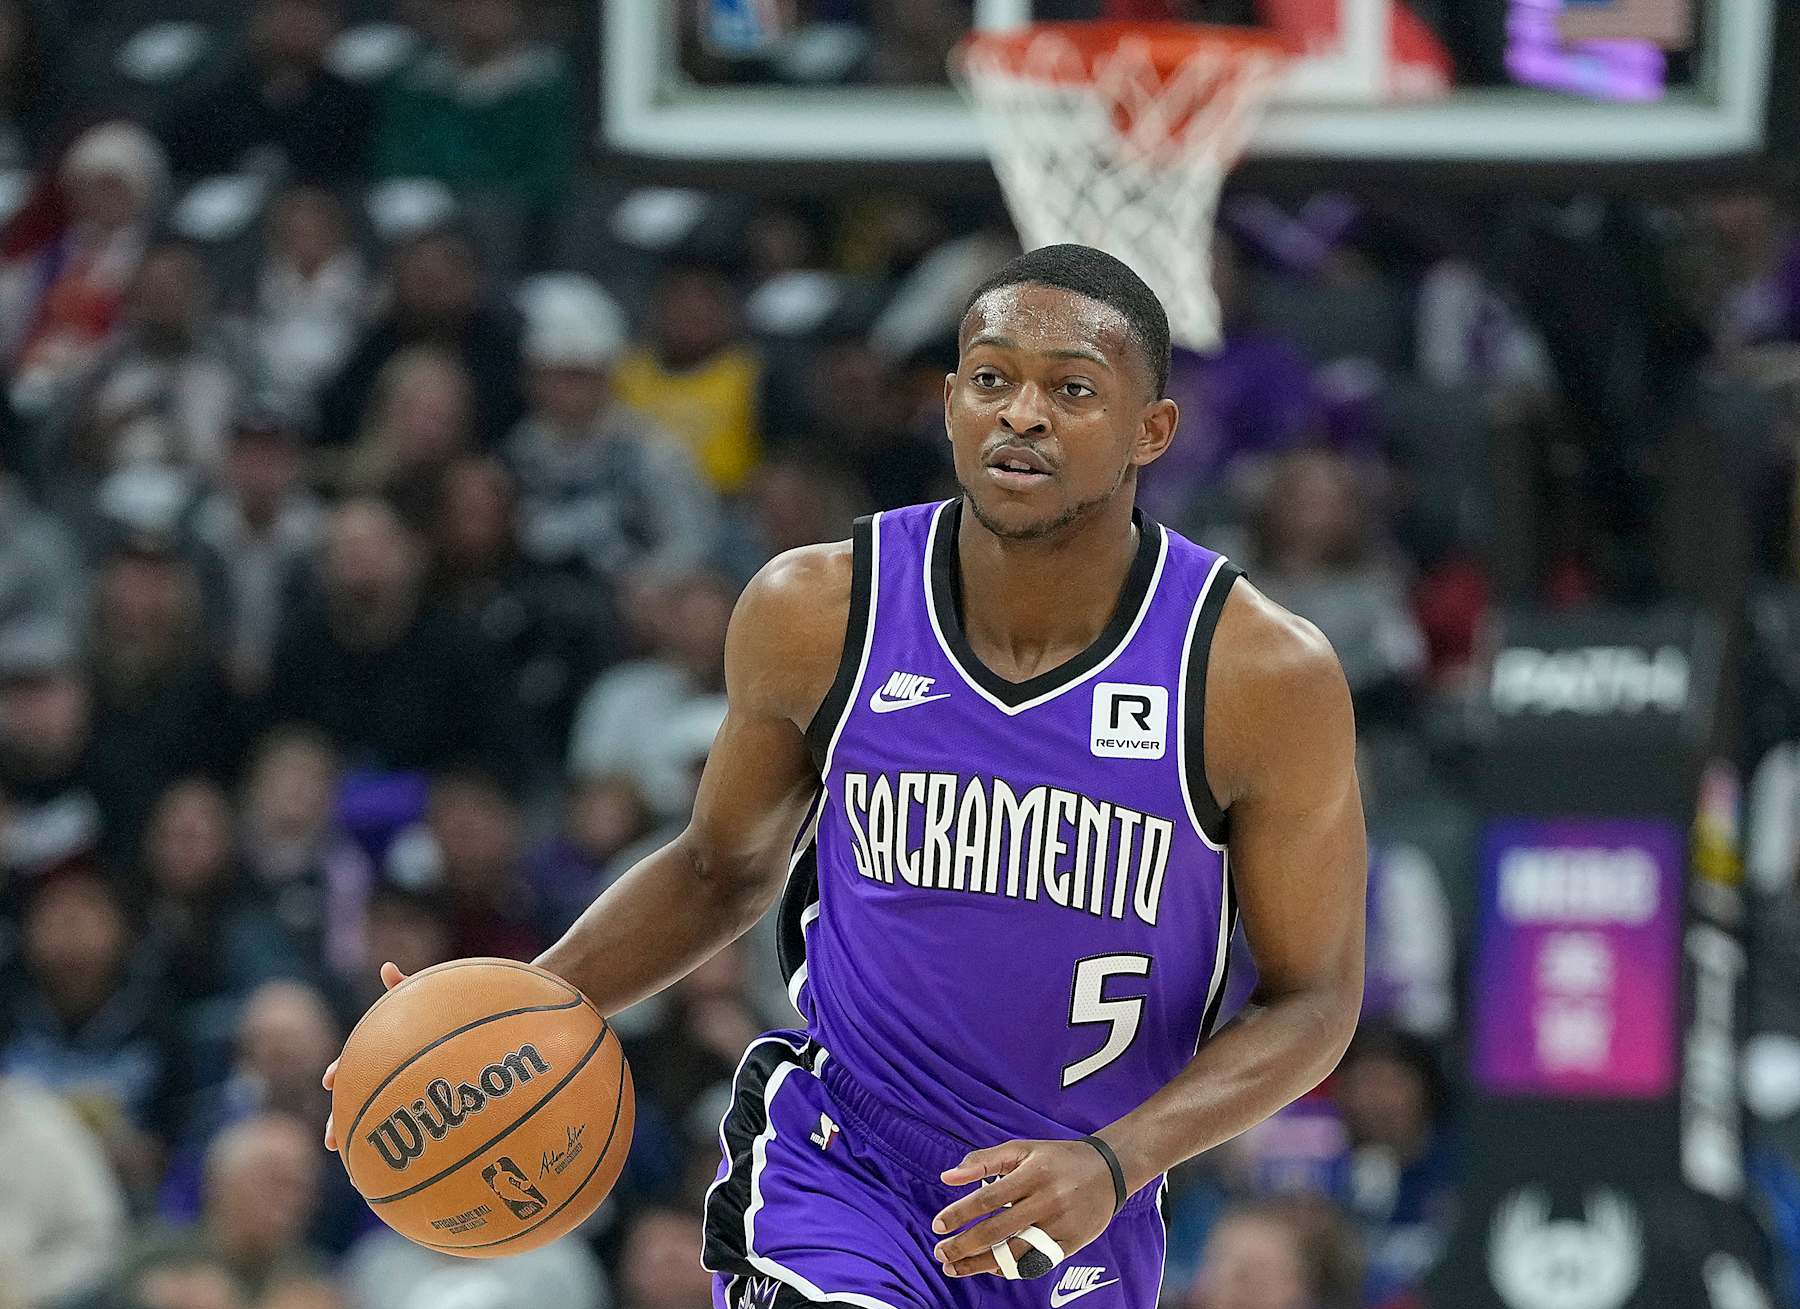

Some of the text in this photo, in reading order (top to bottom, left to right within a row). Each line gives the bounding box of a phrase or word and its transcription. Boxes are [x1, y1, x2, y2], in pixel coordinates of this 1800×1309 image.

[882, 671, 936, 700] NIKE
[1110, 694, 1151, 730] R
[1096, 738, 1160, 750] REVIVER
[844, 770, 1175, 927] SACRAMENTO
[1060, 952, 1153, 1089] 5
[365, 1042, 552, 1172] Wilson
[810, 1132, 824, 1147] NBA
[1058, 1266, 1106, 1290] NIKE
